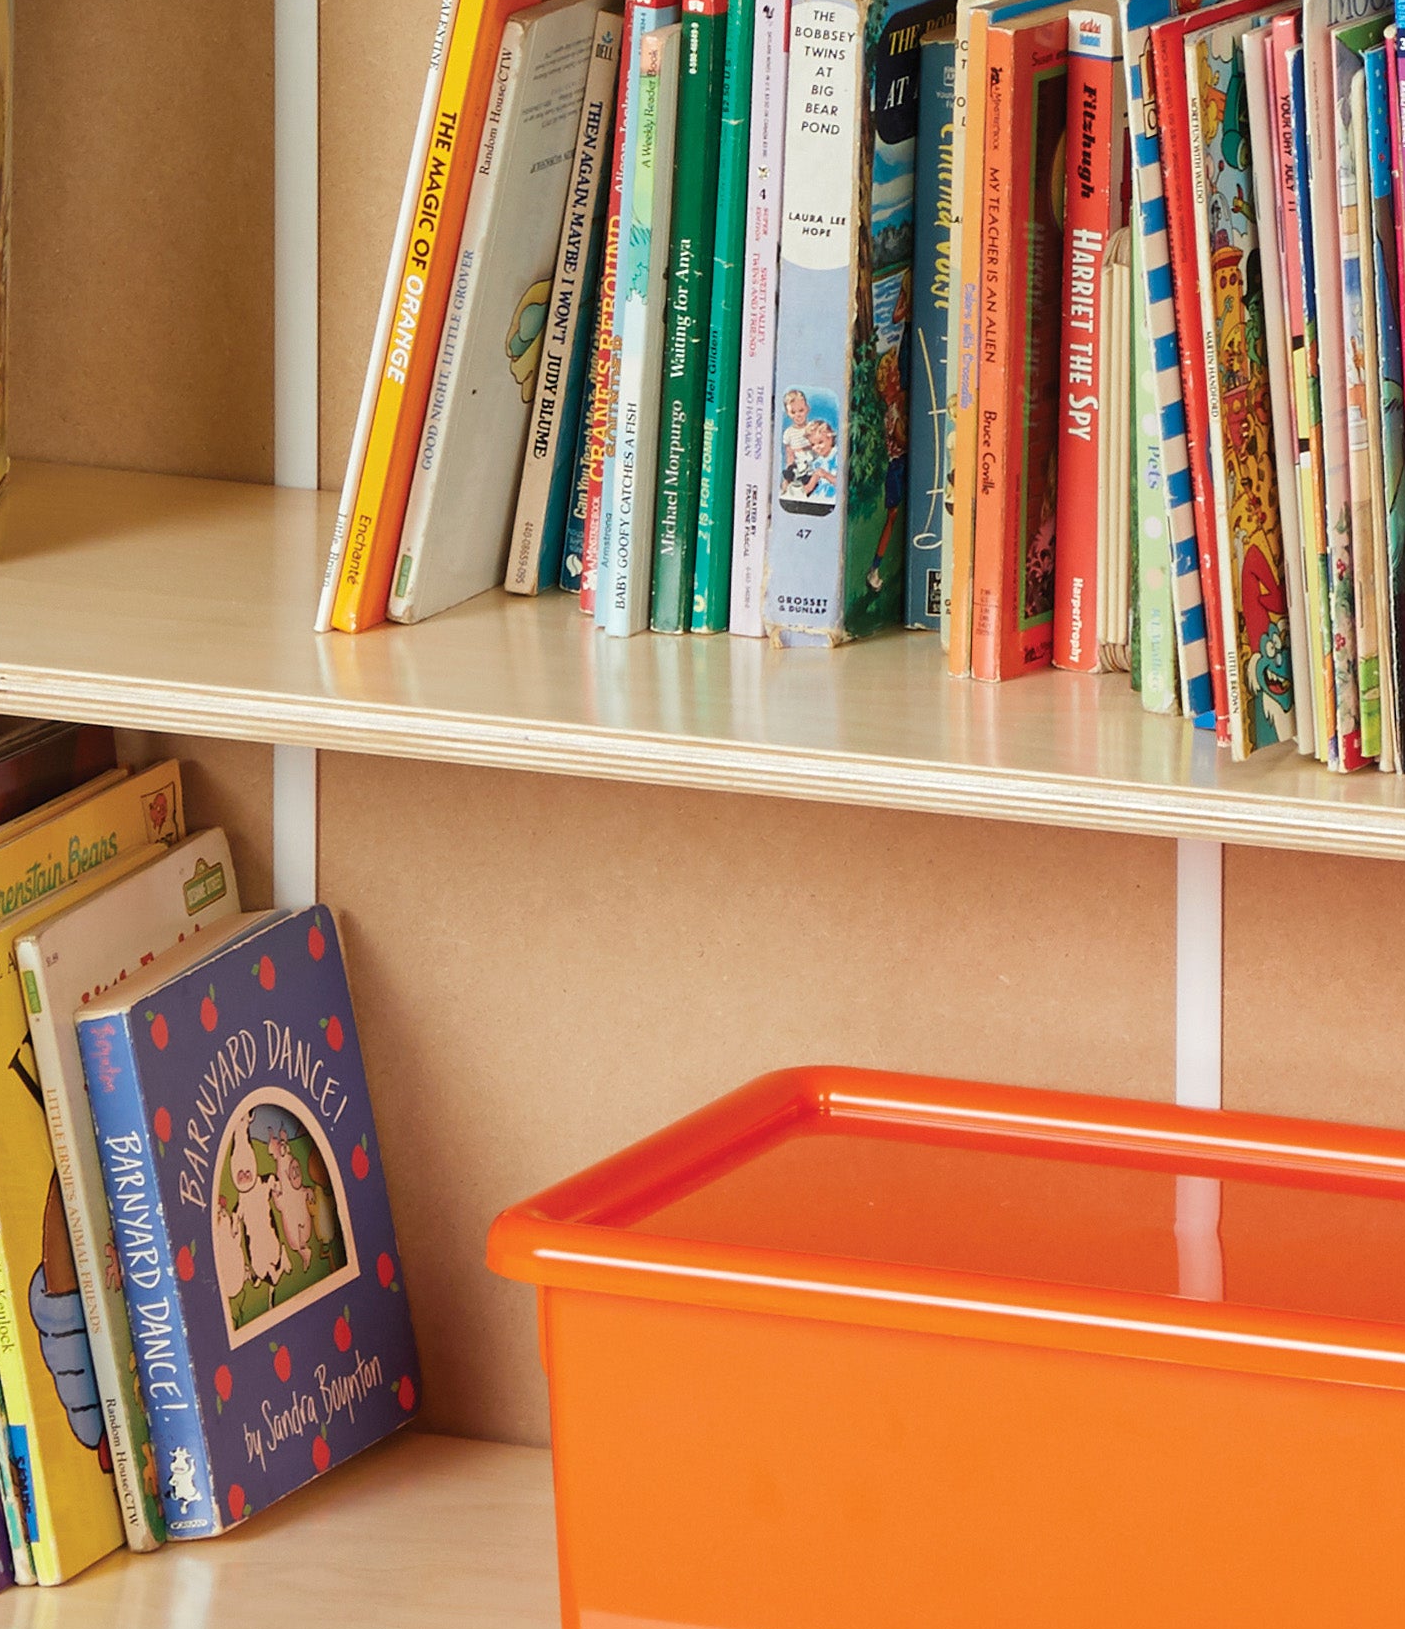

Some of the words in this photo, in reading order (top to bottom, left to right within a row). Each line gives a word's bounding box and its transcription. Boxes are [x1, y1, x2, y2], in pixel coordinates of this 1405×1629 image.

[795, 26, 856, 43] BOBBSEY
[804, 45, 846, 60] TWINS
[805, 103, 838, 117] BEAR
[811, 84, 834, 97] BIG
[801, 121, 840, 135] POND
[1076, 83, 1098, 199] Fitzhugh
[788, 212, 824, 225] LAURA
[830, 216, 846, 226] LEE
[802, 226, 832, 237] HOPE
[1068, 228, 1103, 333] HARRIET
[386, 274, 425, 385] ORANGE
[1067, 391, 1098, 441] SPY
[663, 399, 684, 488] Morpurgo
[660, 490, 679, 557] Michael
[796, 528, 812, 540] 47
[346, 514, 371, 586] Enchanté
[778, 595, 828, 607] GROSSET
[788, 605, 827, 614] DUNLAP
[1068, 576, 1084, 664] HarperTrophy
[67, 832, 118, 881] Bears
[179, 1029, 258, 1211] BARNYARD
[103, 1128, 160, 1288] BARNYARD
[135, 1295, 189, 1415] DANCE!
[261, 1389, 317, 1453] Sandra
[313, 1350, 384, 1425] Boynton
